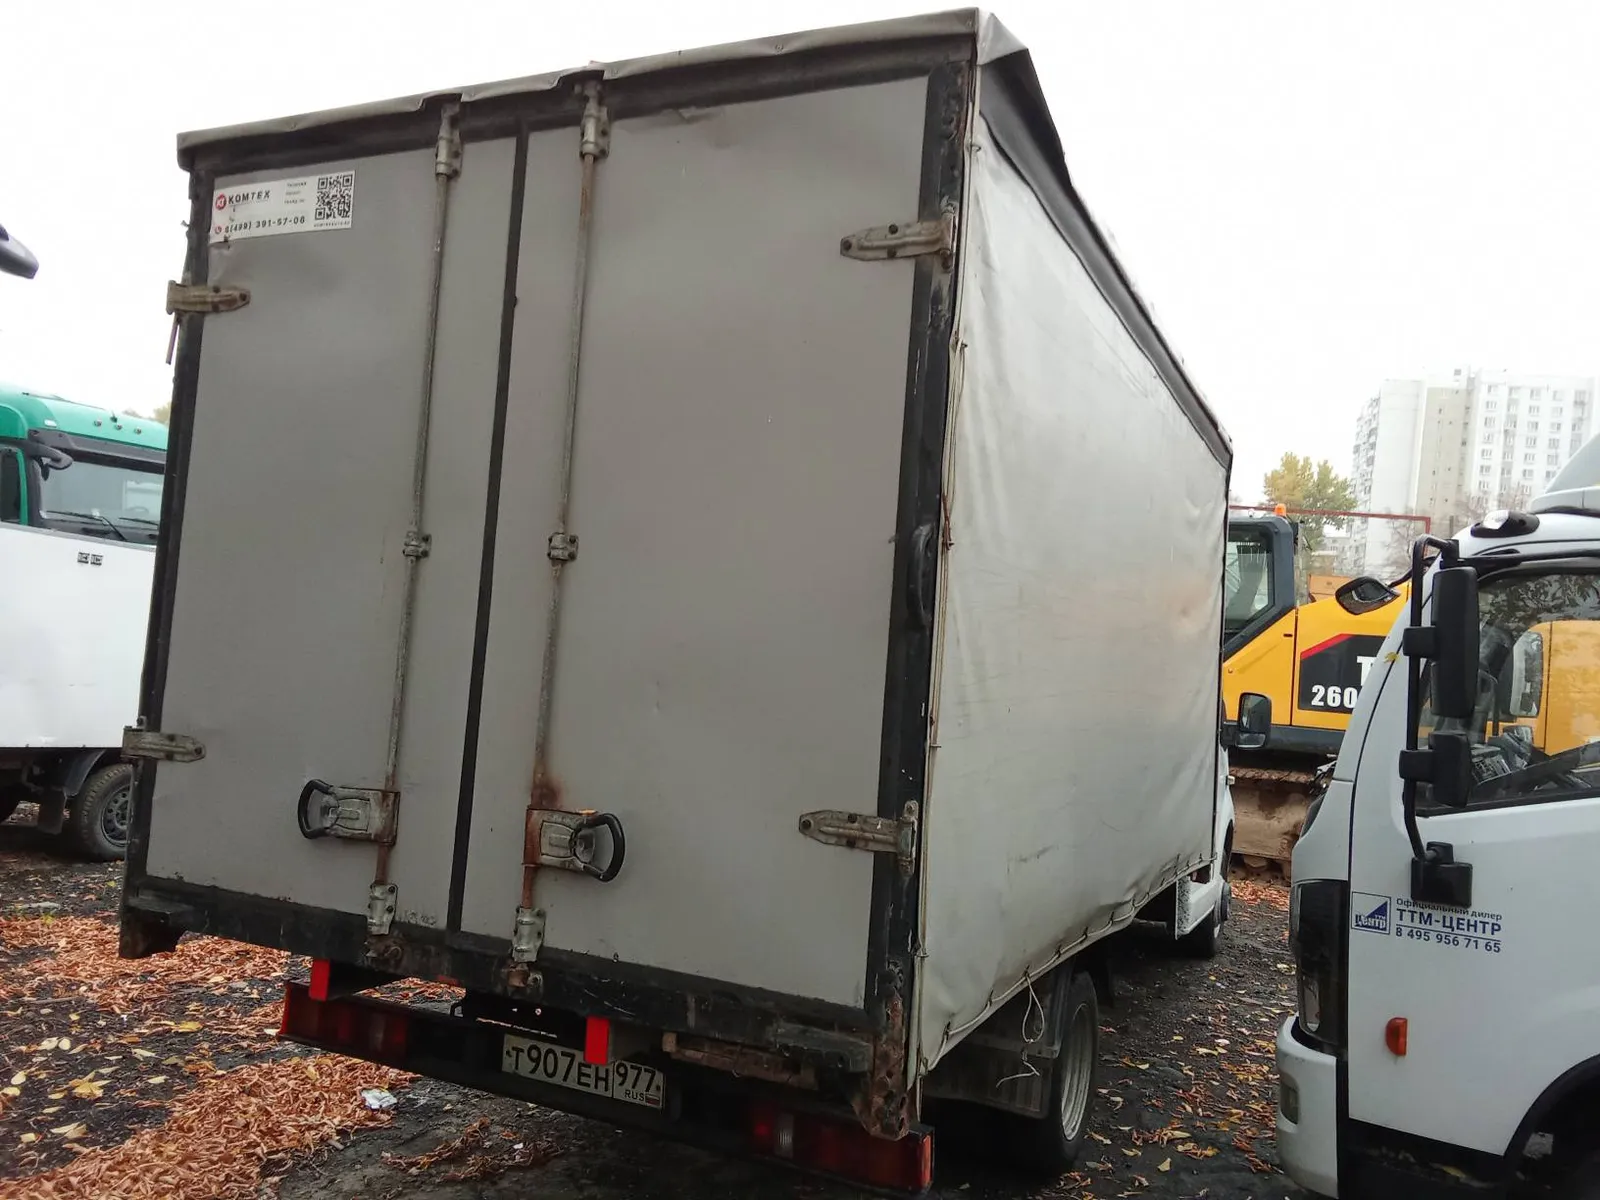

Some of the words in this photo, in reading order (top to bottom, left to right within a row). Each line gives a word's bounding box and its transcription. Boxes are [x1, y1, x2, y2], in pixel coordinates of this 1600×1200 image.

[1396, 907, 1502, 936] ТТМ-ЦЕНТР
[1470, 909, 1503, 921] дилер
[1395, 926, 1403, 938] 8
[1407, 929, 1431, 942] 495
[1436, 933, 1460, 947] 956
[1464, 937, 1479, 950] 71
[1484, 941, 1501, 954] 65
[615, 1061, 657, 1093] 977
[624, 1089, 645, 1101] RUS
